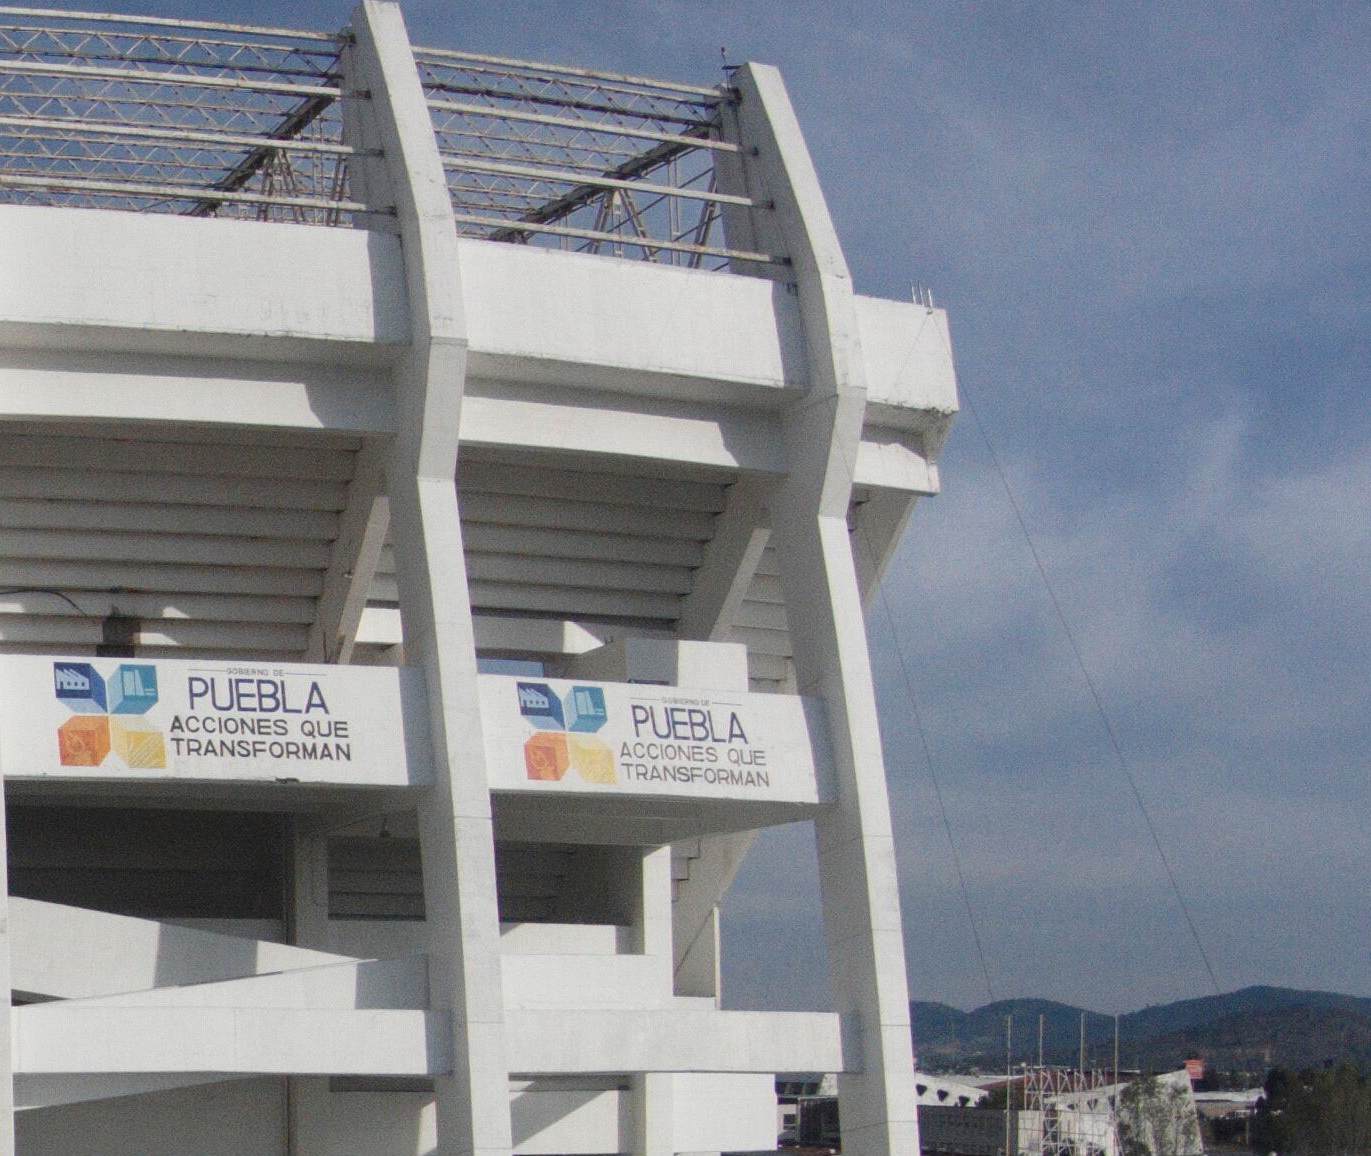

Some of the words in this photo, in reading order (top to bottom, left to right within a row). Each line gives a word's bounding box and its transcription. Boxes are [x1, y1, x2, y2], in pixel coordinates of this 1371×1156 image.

[188, 677, 330, 715] PUEBLA
[170, 715, 288, 737] ACCIONES
[301, 719, 349, 738] QUE
[631, 704, 748, 744] PUEBLA
[170, 738, 351, 761] TRANSFORMAN
[620, 742, 718, 763] ACCIONES
[728, 748, 766, 766] QUE
[621, 763, 770, 787] TRANSFORMAN
